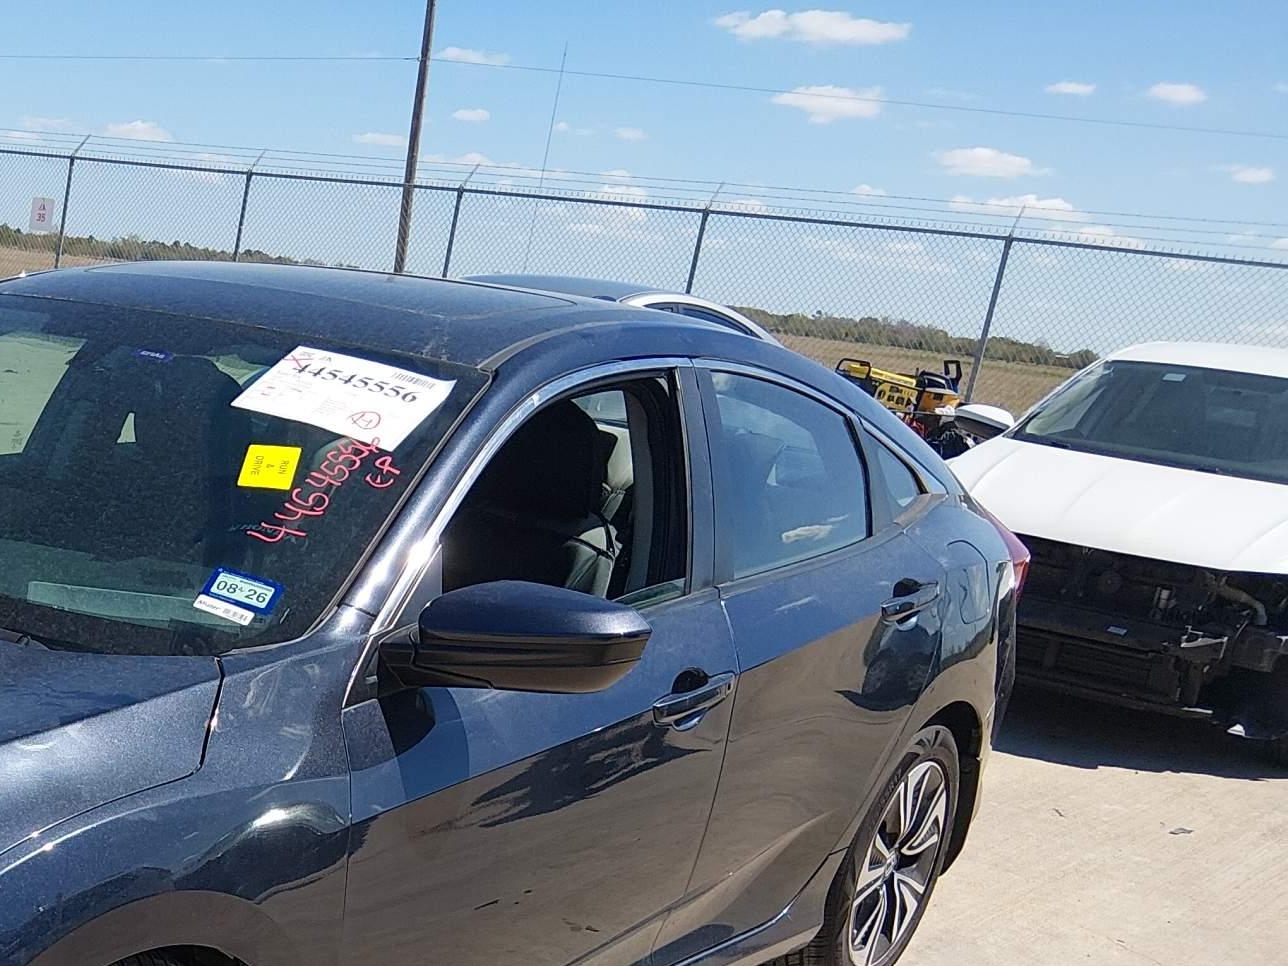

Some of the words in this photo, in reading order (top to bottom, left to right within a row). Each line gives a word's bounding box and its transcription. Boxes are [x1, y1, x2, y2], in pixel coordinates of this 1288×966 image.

[293, 363, 423, 403] 44545556
[251, 456, 264, 476] DRIVE
[278, 459, 290, 475] RUN
[216, 580, 239, 594] 08
[244, 588, 268, 603] 26
